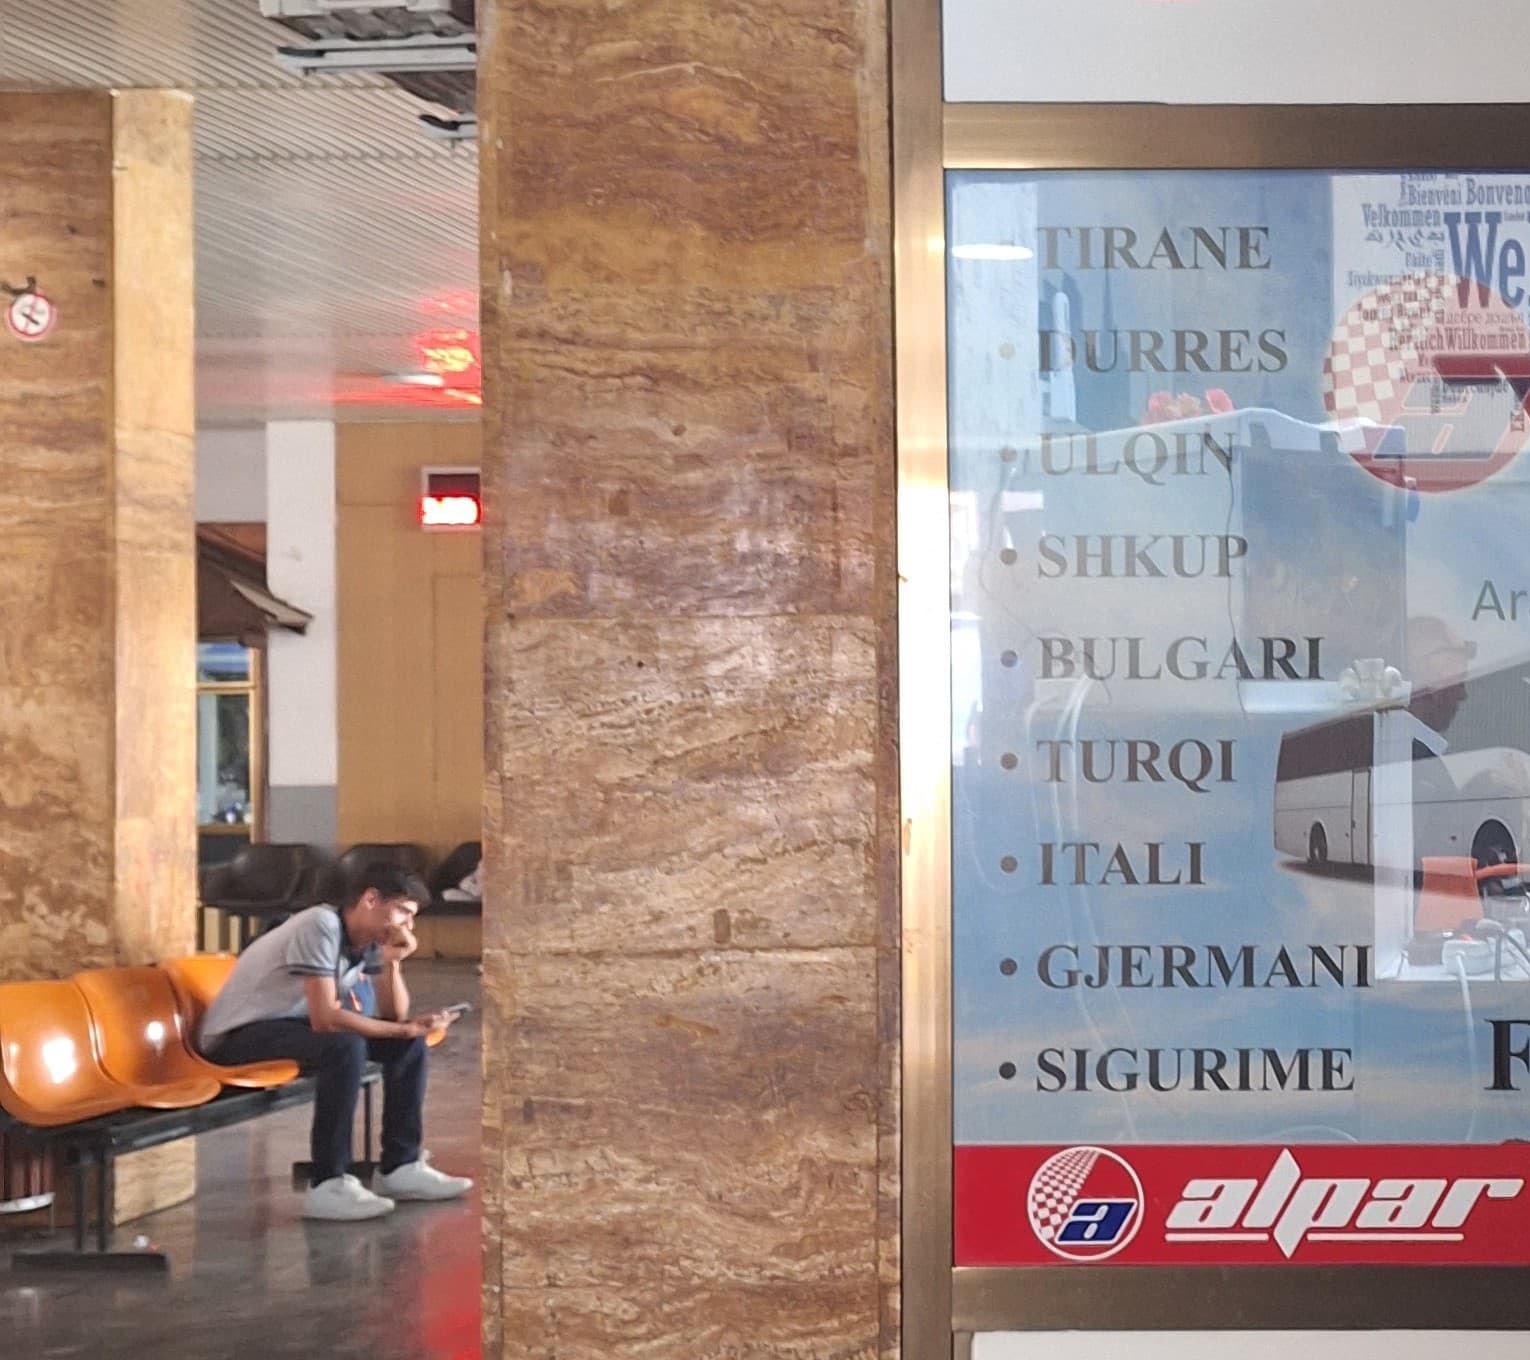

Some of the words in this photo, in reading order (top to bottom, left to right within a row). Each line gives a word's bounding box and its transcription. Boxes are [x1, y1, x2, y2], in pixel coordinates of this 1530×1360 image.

[1361, 203, 1441, 228] Velkommen
[1037, 225, 1271, 271] TIRANE
[1038, 328, 1289, 374] DURRES
[1039, 432, 1235, 487] ULQIN
[1036, 534, 1249, 580] SHKUP
[1036, 635, 1324, 681] BULGARI
[1037, 739, 1238, 793] TURQI
[1037, 842, 1207, 886] ITALI
[1036, 944, 1373, 989] GJERMANI
[1035, 1047, 1356, 1094] SIGURIME
[1166, 1147, 1525, 1259] alpar
